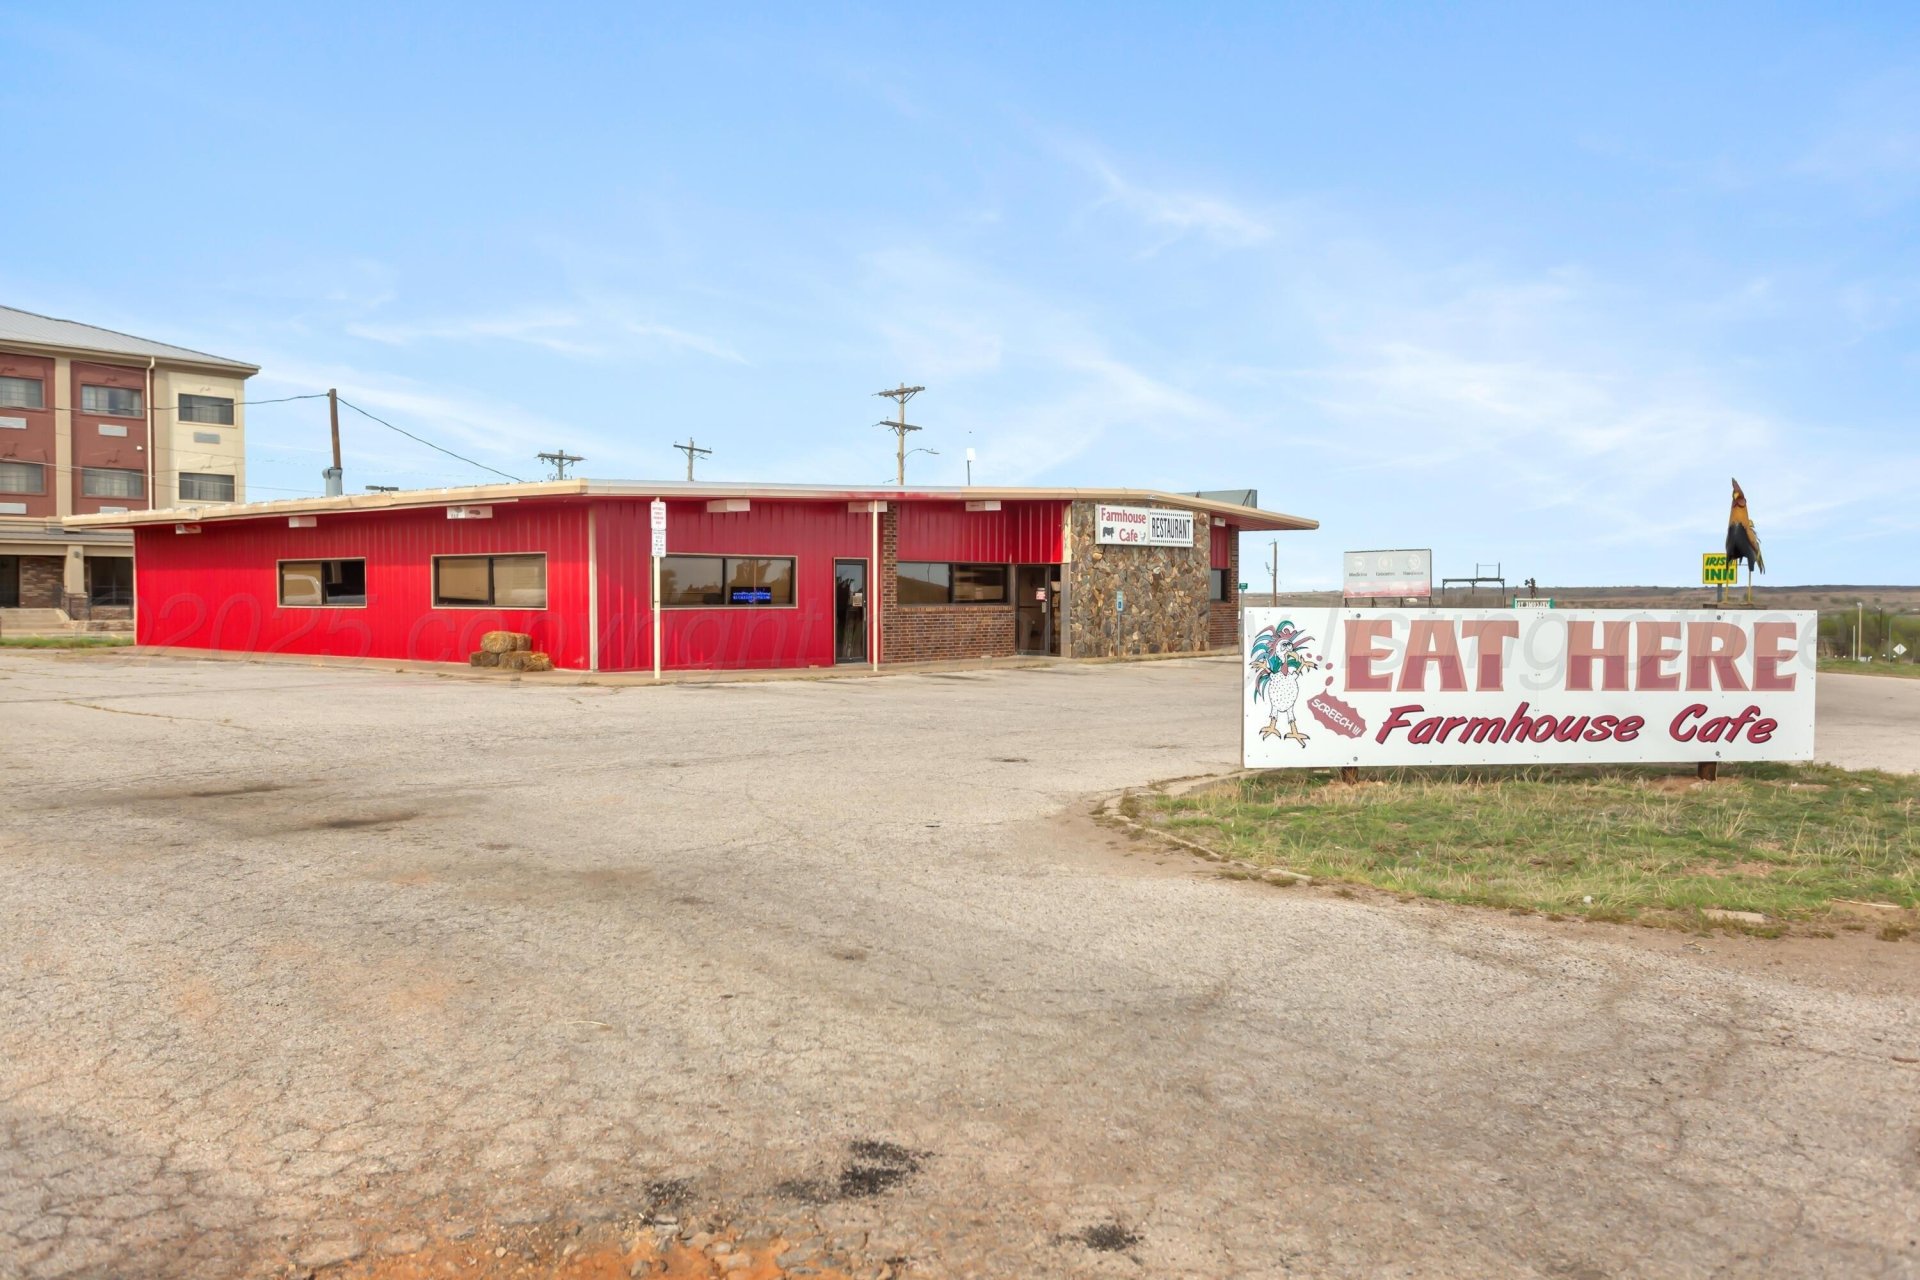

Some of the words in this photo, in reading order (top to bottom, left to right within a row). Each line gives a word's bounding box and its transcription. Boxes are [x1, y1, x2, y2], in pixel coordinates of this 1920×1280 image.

[1101, 507, 1147, 525] Farmhouse
[1119, 528, 1139, 543] Cafe
[1151, 517, 1191, 540] RESTAURANT
[1705, 568, 1735, 581] INN
[1344, 619, 1519, 692] EAT
[1565, 620, 1798, 692] HERE
[1375, 701, 1645, 745] Farmhouse
[1669, 703, 1778, 745] Cafe
